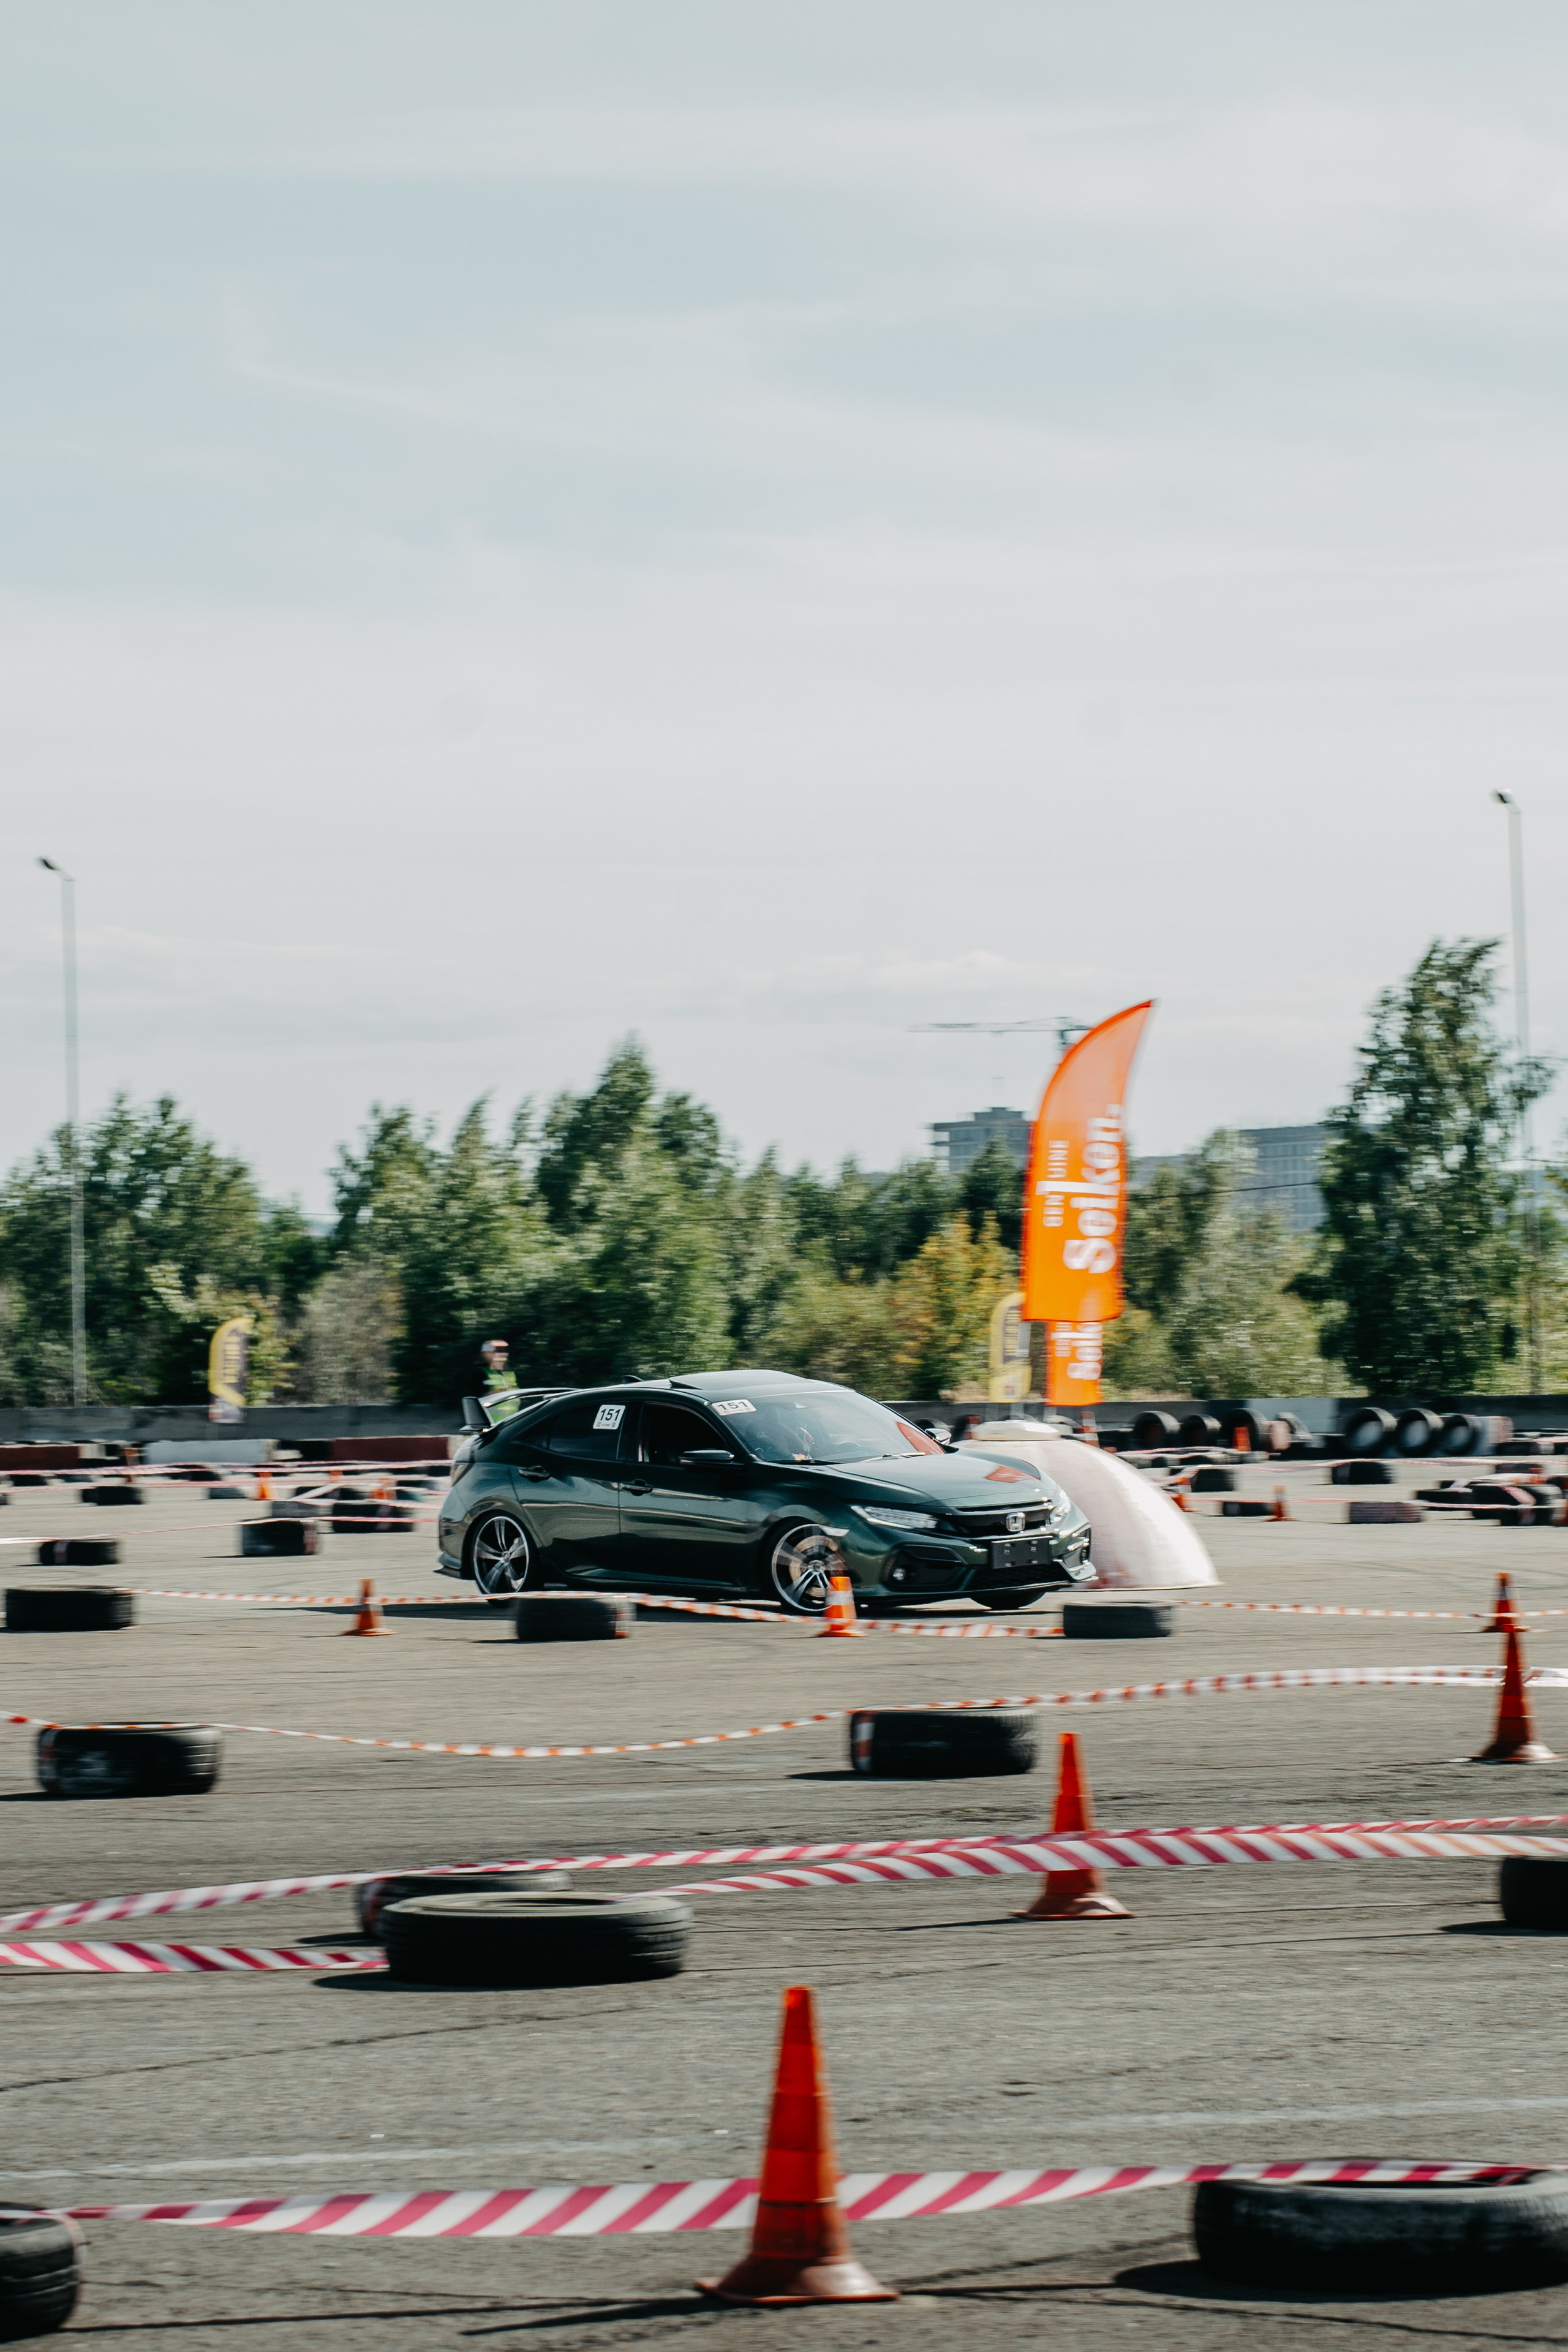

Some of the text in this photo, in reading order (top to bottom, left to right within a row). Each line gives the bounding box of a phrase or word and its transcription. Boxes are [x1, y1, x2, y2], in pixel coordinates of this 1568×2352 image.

[1042, 1140, 1069, 1227] GENUINE
[1050, 1322, 1102, 1380] Seik
[600, 1409, 622, 1422] 151
[718, 1401, 748, 1410] 151
